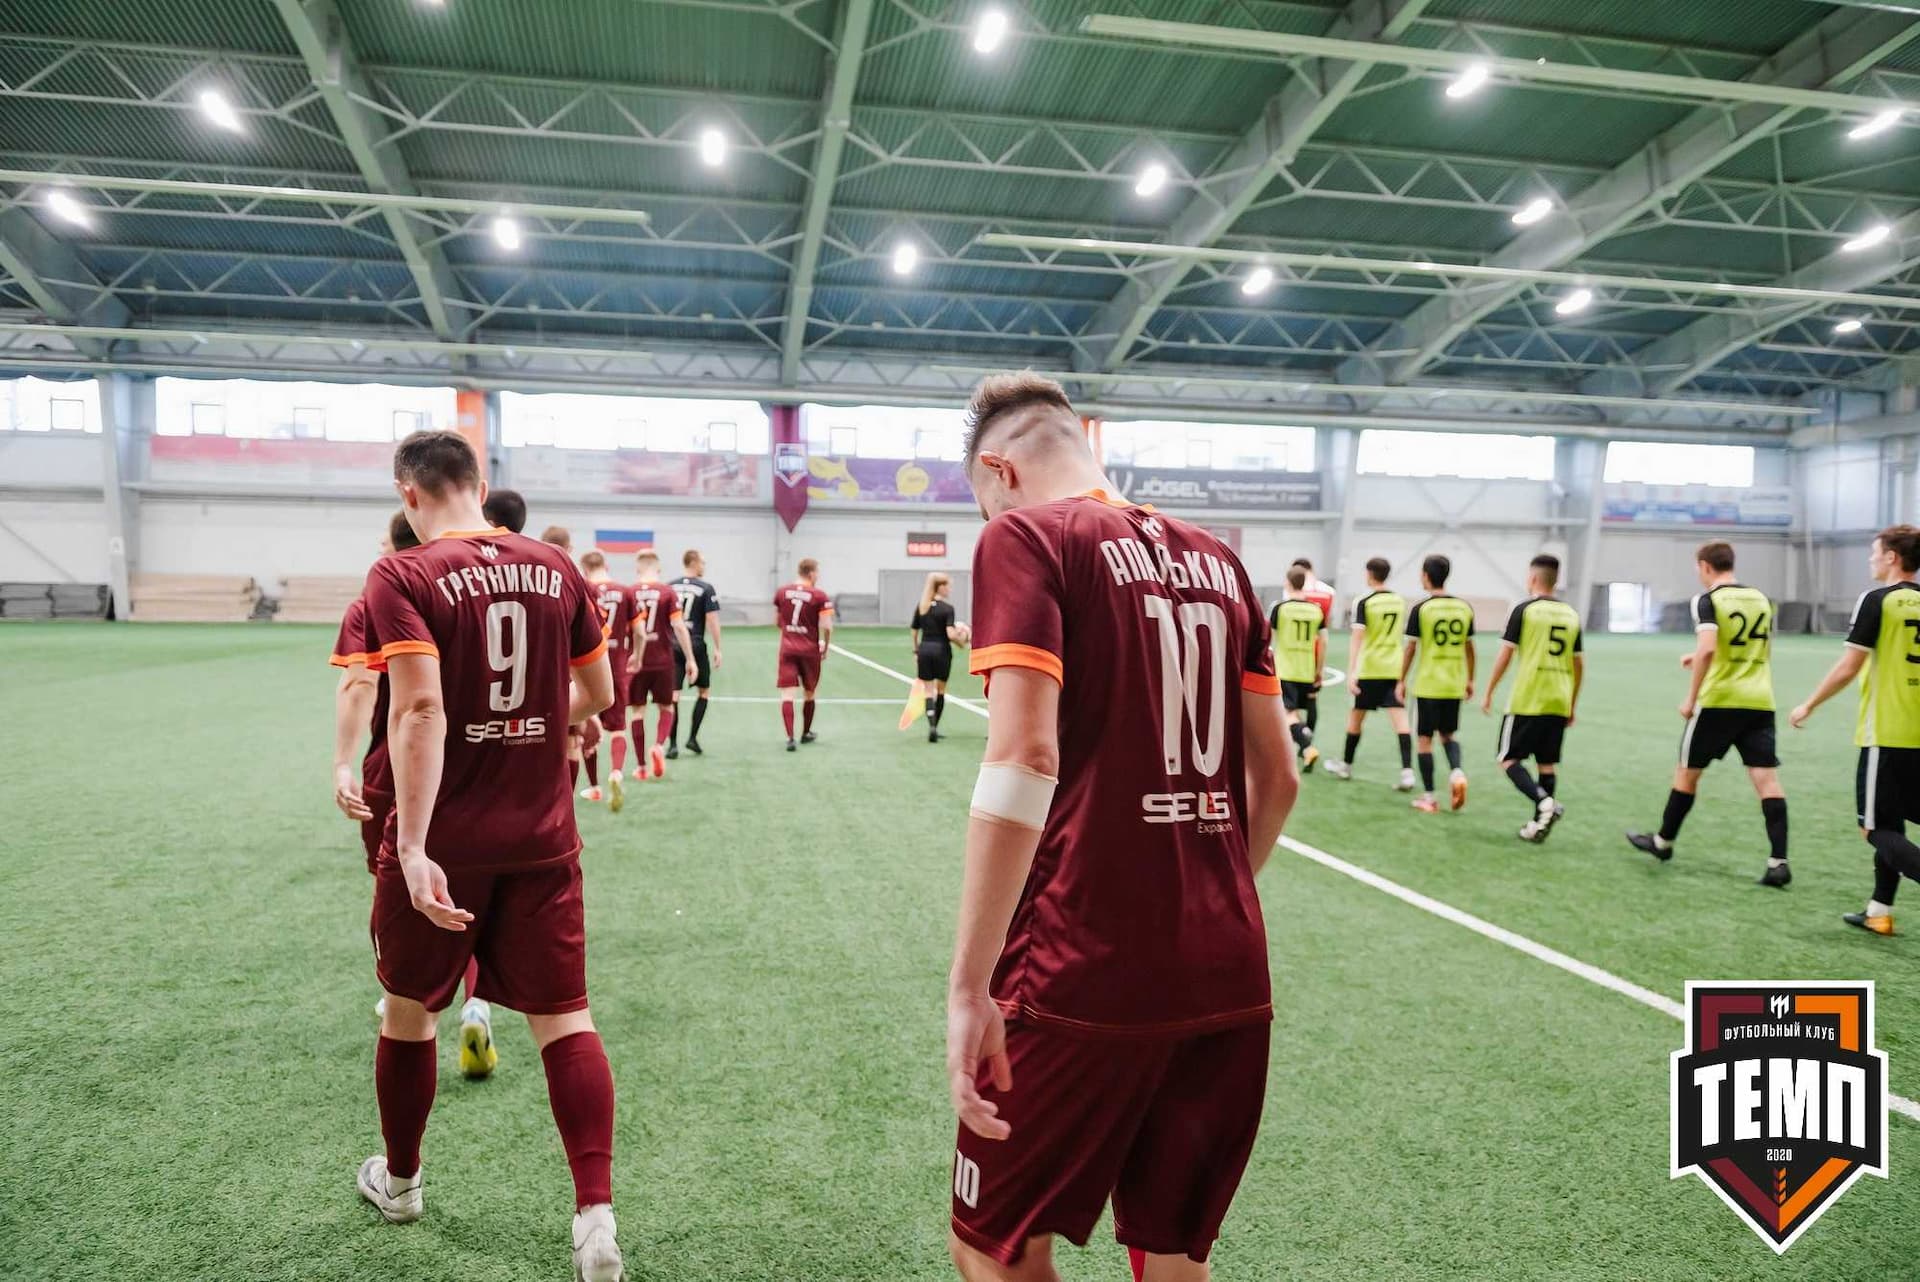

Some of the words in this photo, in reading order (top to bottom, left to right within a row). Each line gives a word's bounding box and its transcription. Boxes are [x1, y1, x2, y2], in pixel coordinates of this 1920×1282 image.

[436, 564, 563, 606] ГРЕЧНИКОВ
[1293, 619, 1311, 641] 11
[1383, 613, 1398, 636] 7
[1433, 619, 1464, 646] 69
[1728, 612, 1769, 648] 24
[486, 600, 528, 712] 9
[1548, 626, 1567, 656] 5
[1143, 594, 1228, 778] 10
[465, 717, 546, 743] SEUS
